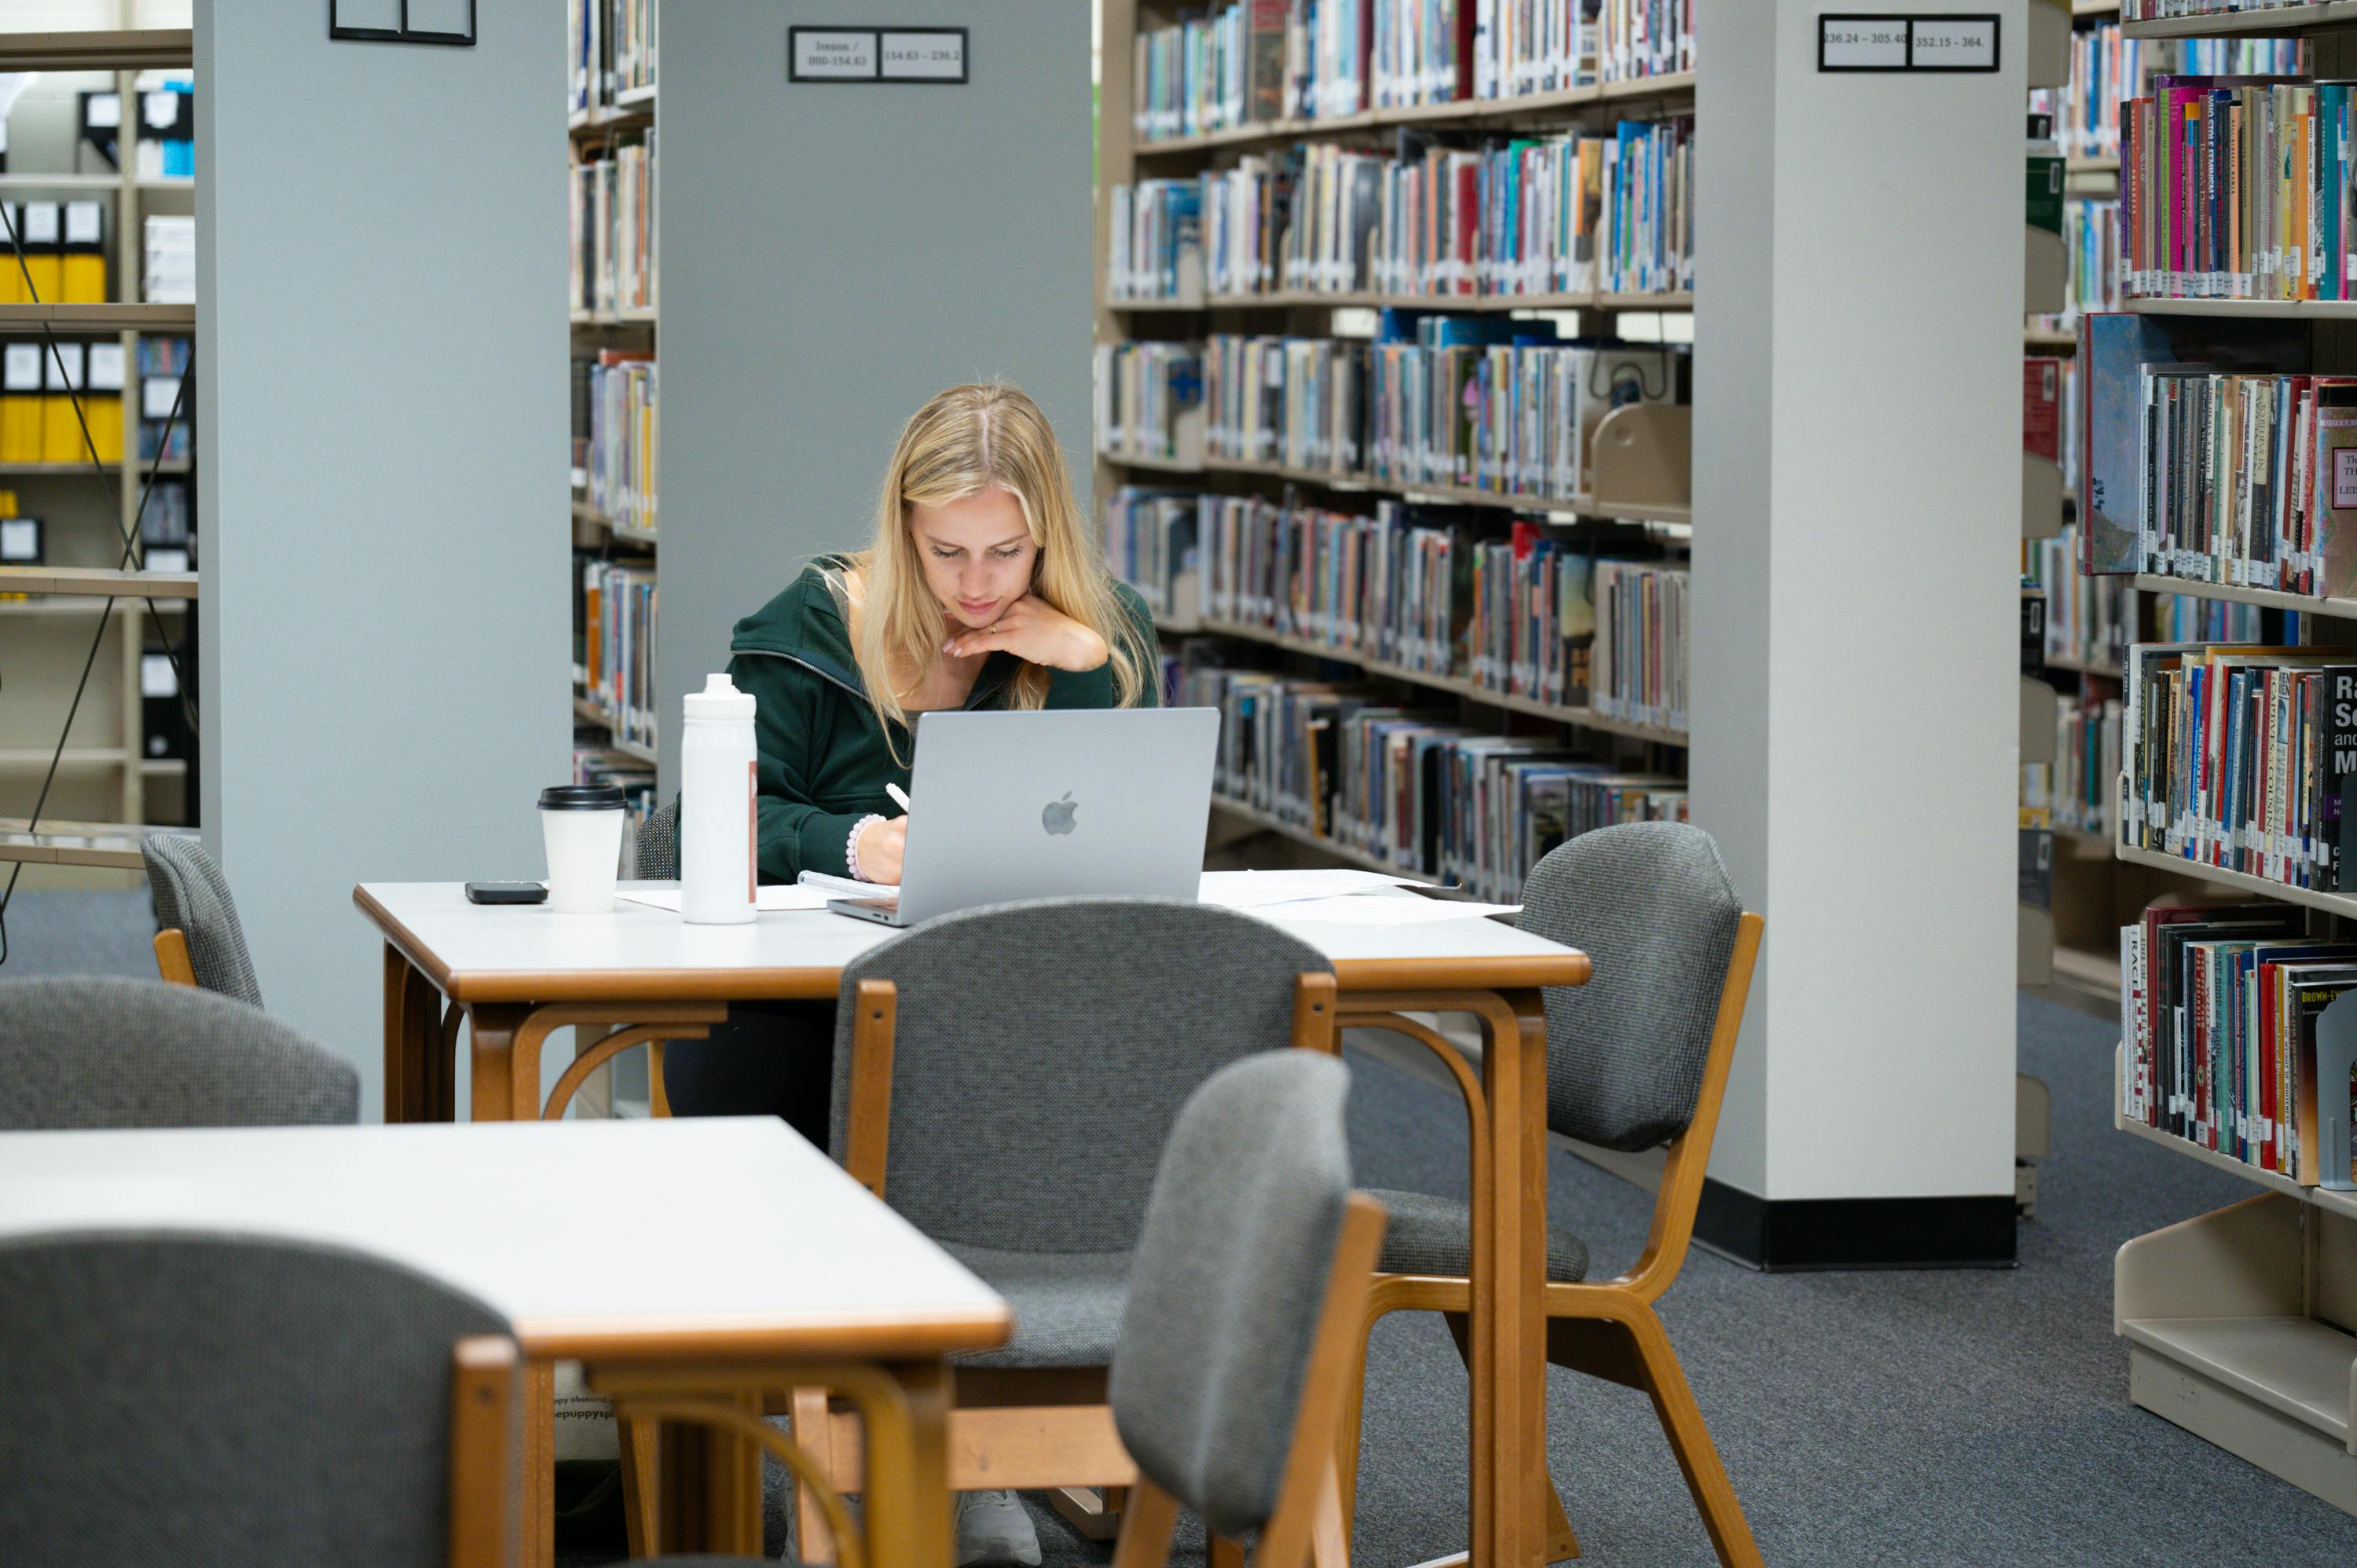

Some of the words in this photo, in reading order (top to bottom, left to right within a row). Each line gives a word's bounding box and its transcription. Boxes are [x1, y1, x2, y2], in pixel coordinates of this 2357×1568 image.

[1916, 37, 1951, 47] 352.15
[2337, 676, 2357, 699] R
[2266, 767, 2275, 837] COUSINS
[2302, 991, 2346, 1003] BROWN-EY
[553, 1408, 614, 1420] epuppysp
